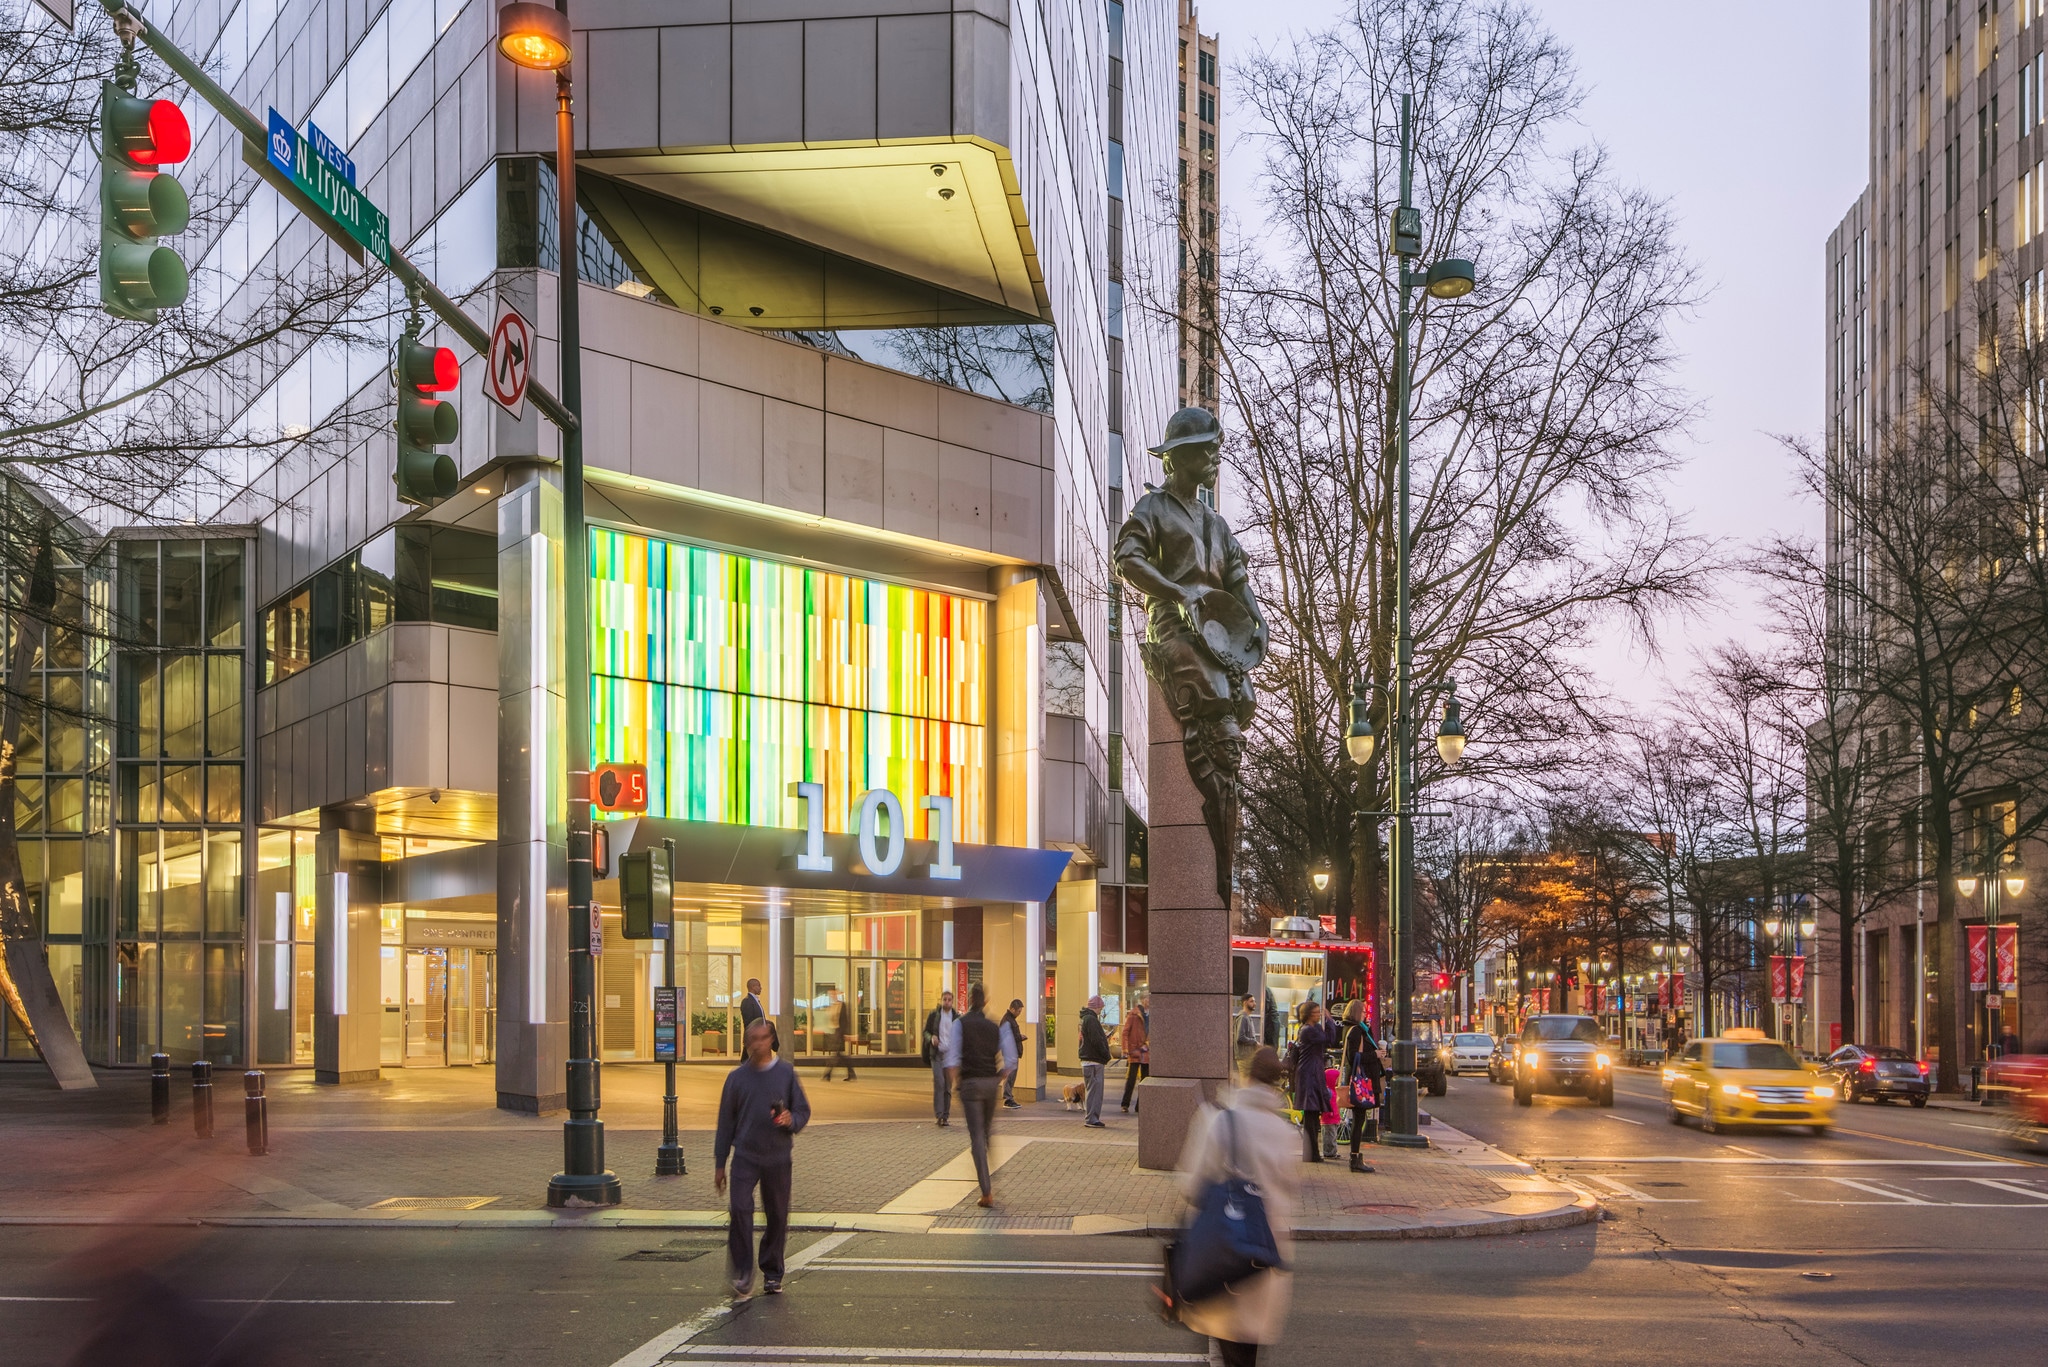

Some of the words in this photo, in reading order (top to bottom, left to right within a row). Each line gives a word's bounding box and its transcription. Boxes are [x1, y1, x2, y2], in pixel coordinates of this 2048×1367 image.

[314, 128, 351, 178] WEST
[296, 137, 313, 185] N.
[316, 155, 359, 226] Tryon
[376, 211, 386, 238] St
[370, 229, 387, 261] 100
[631, 773, 644, 804] 5
[787, 781, 962, 881] 101
[423, 928, 444, 938] ONE
[447, 929, 496, 939] HUNDRED
[1326, 977, 1366, 1001] HALAL
[573, 1000, 588, 1013] 225
